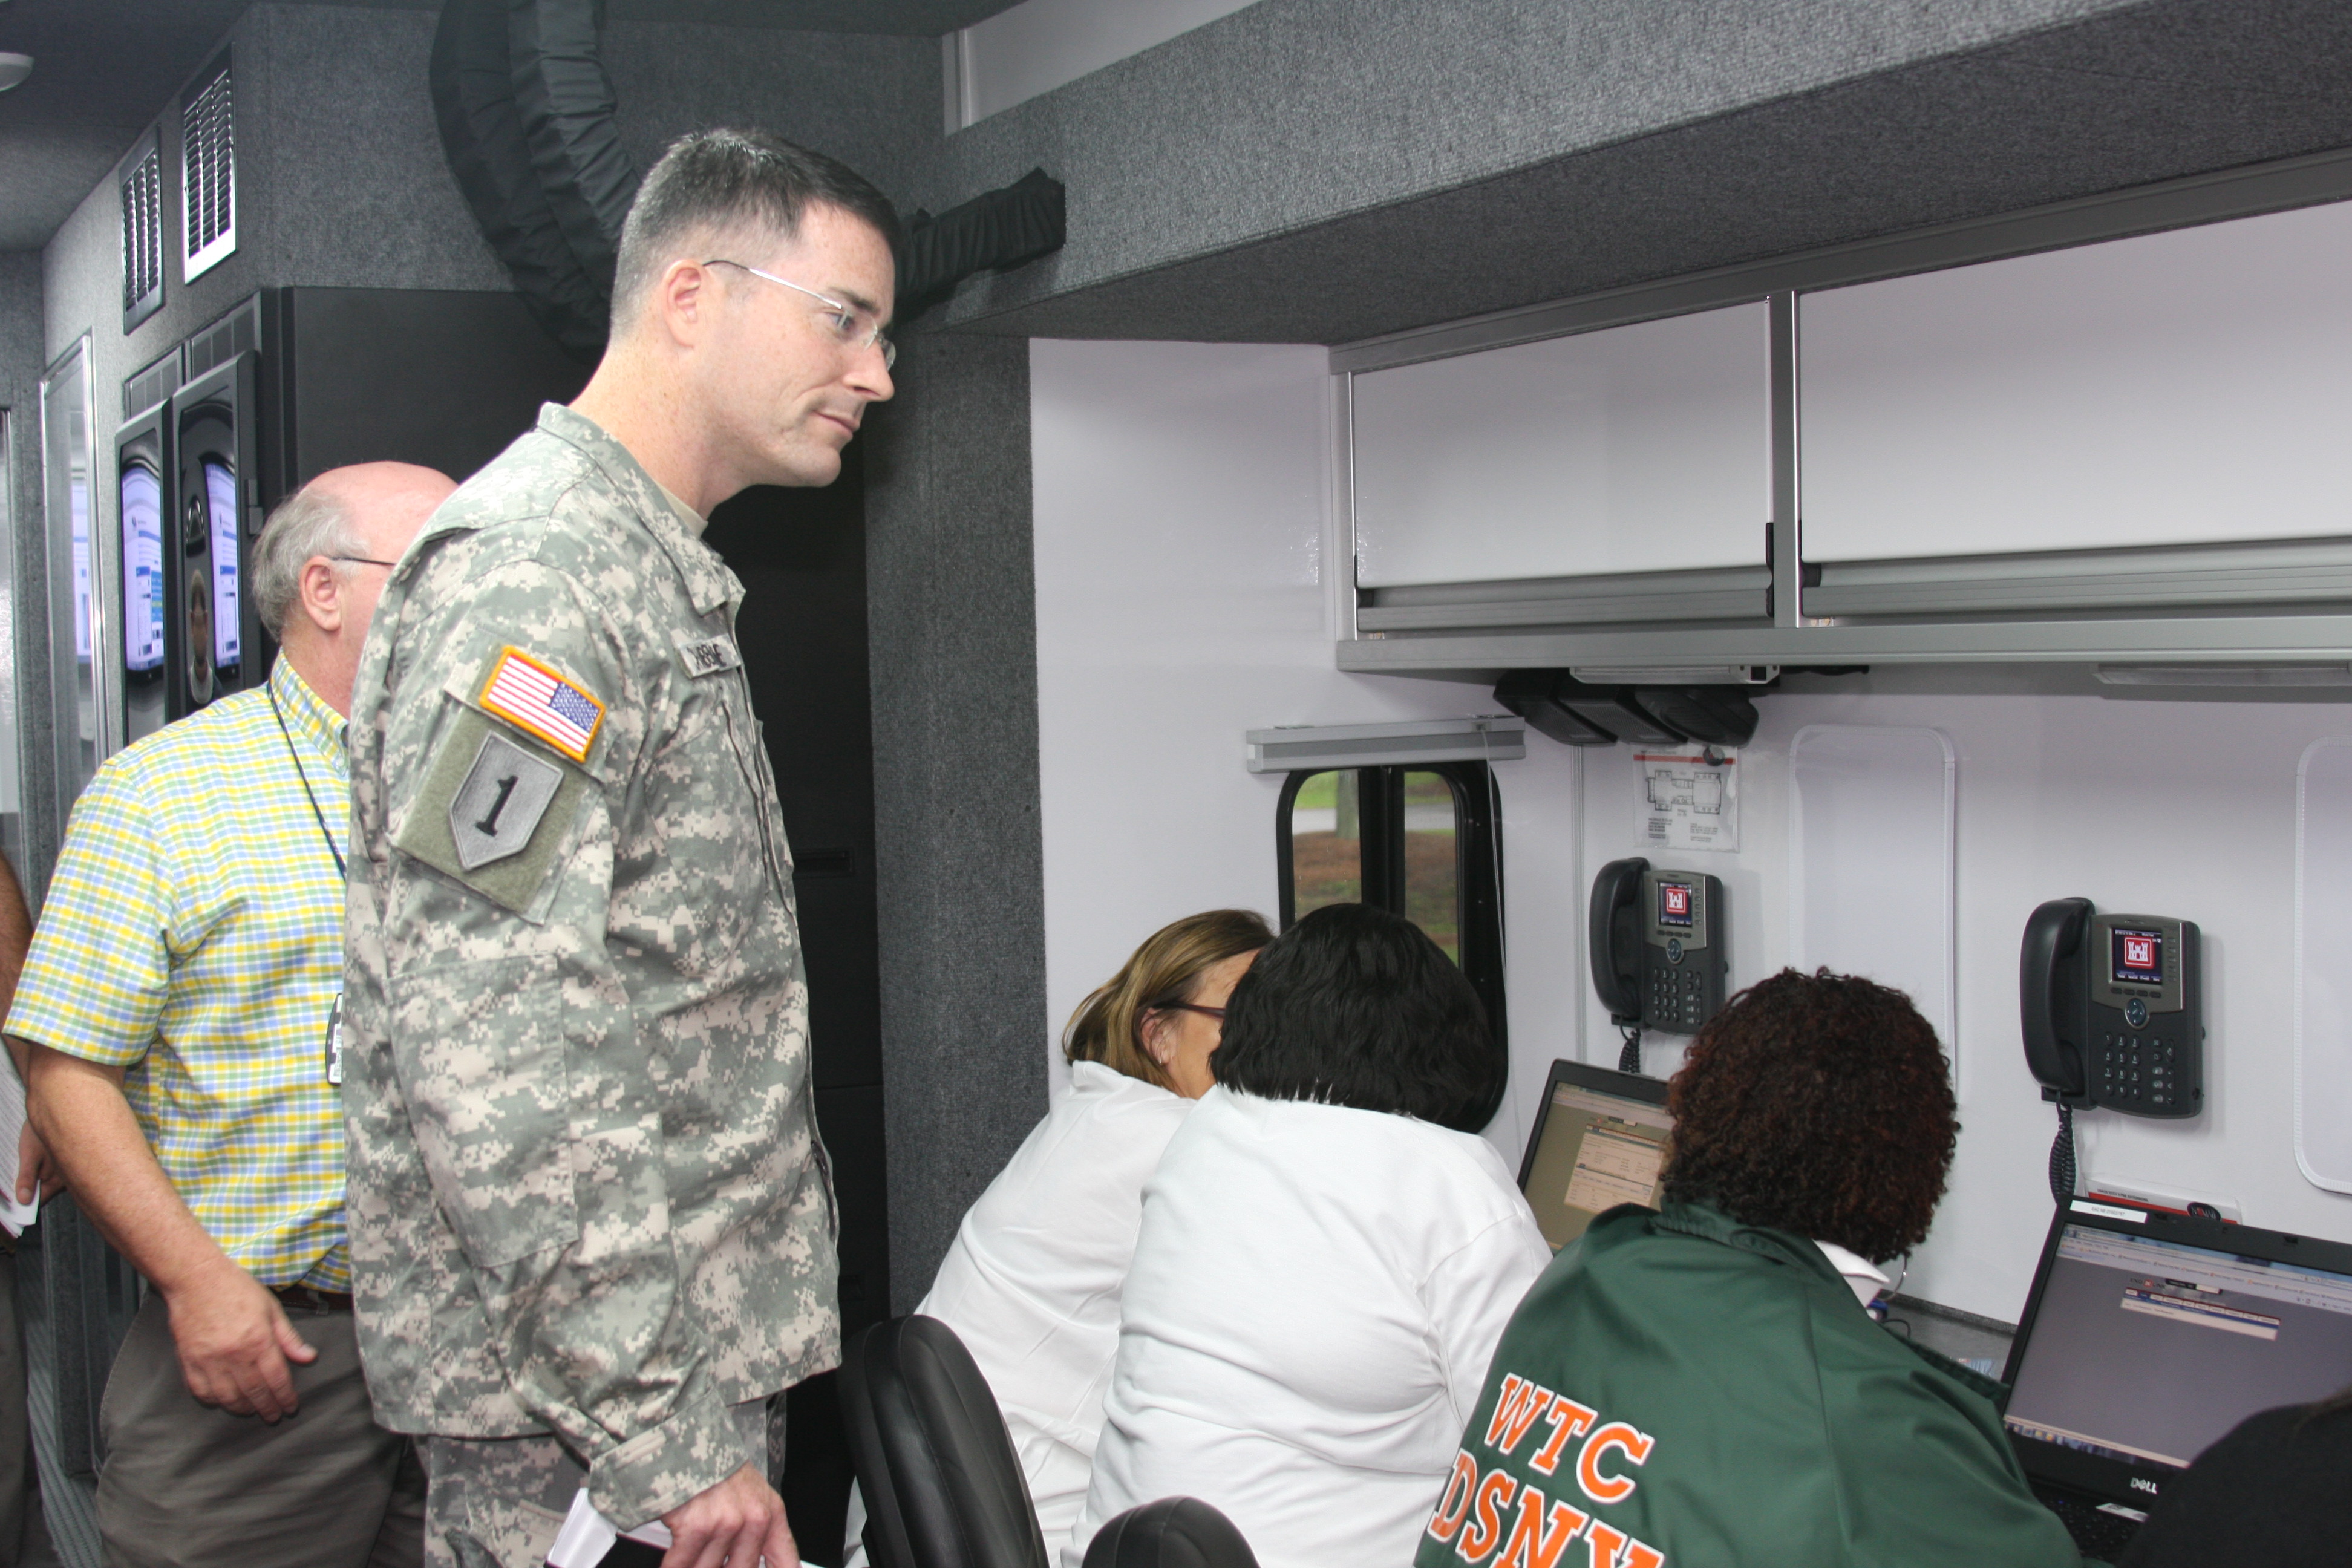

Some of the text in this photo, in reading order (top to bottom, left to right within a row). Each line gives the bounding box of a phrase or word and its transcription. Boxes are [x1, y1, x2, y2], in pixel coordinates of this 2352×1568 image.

[475, 775, 518, 837] 1
[1484, 1372, 1655, 1504] WTC
[2130, 1477, 2157, 1494] DELL
